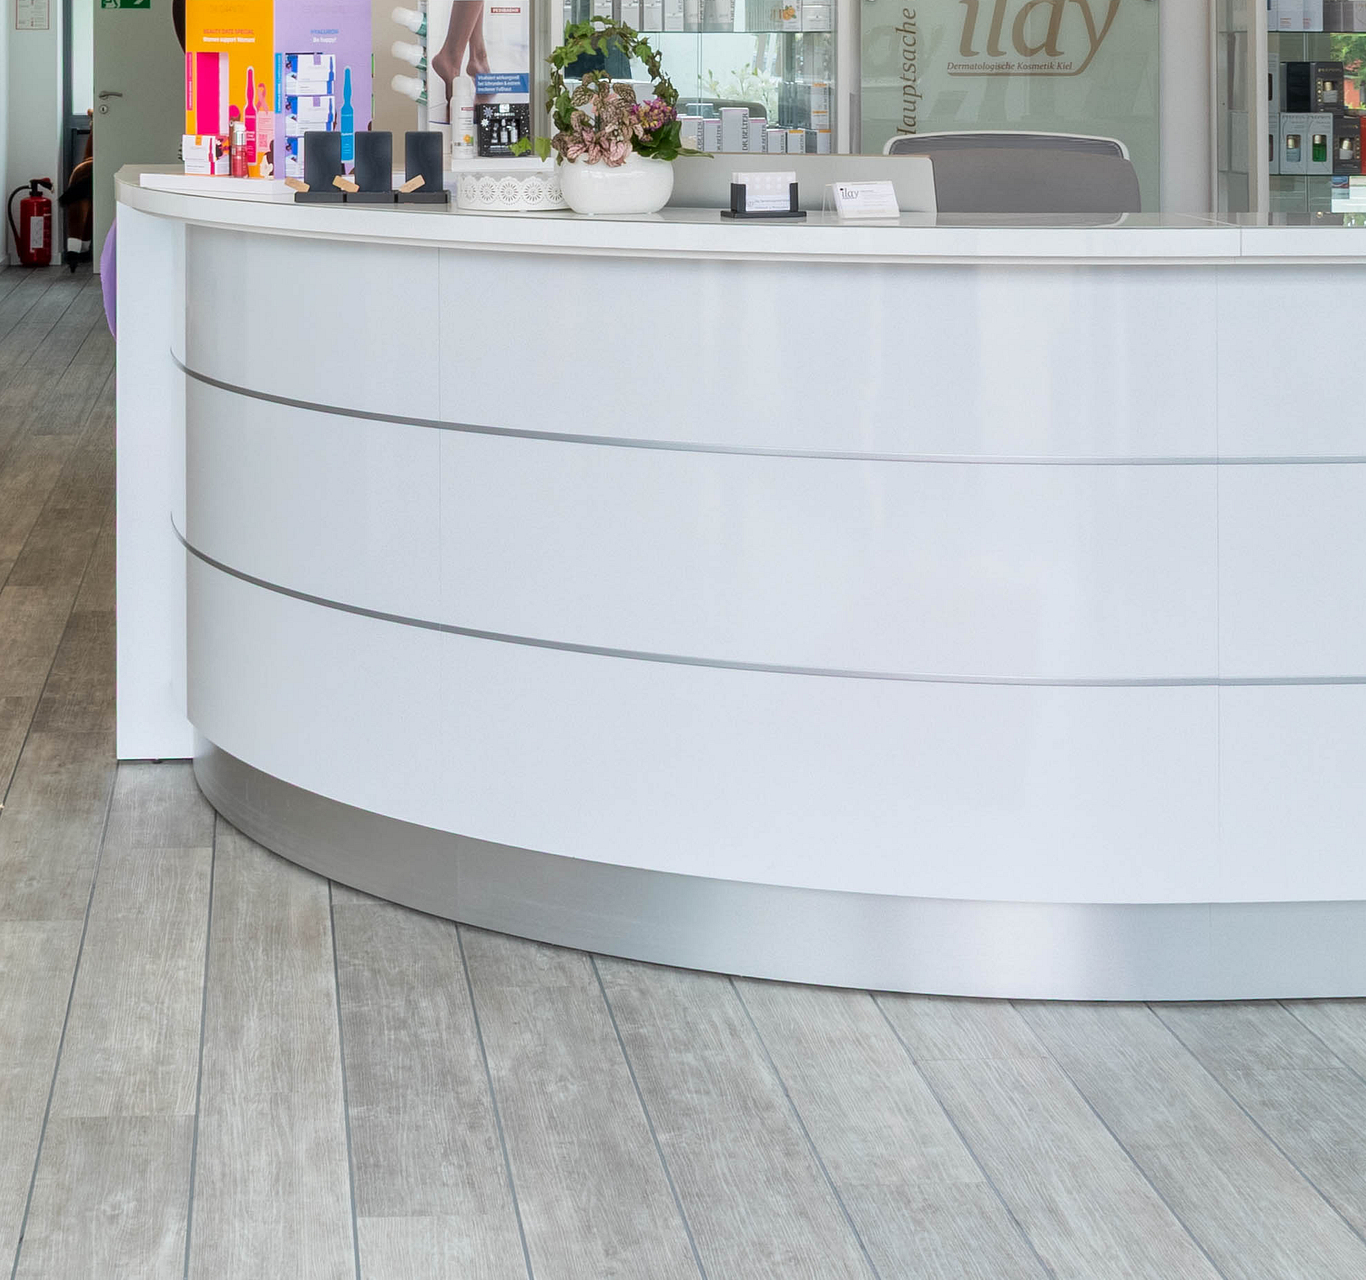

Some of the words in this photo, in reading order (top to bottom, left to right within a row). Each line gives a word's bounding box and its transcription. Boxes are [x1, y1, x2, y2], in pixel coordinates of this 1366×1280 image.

[947, 61, 1015, 72] Dermatologische
[1017, 61, 1055, 71] Kosmetik
[1056, 61, 1073, 70] Kiel
